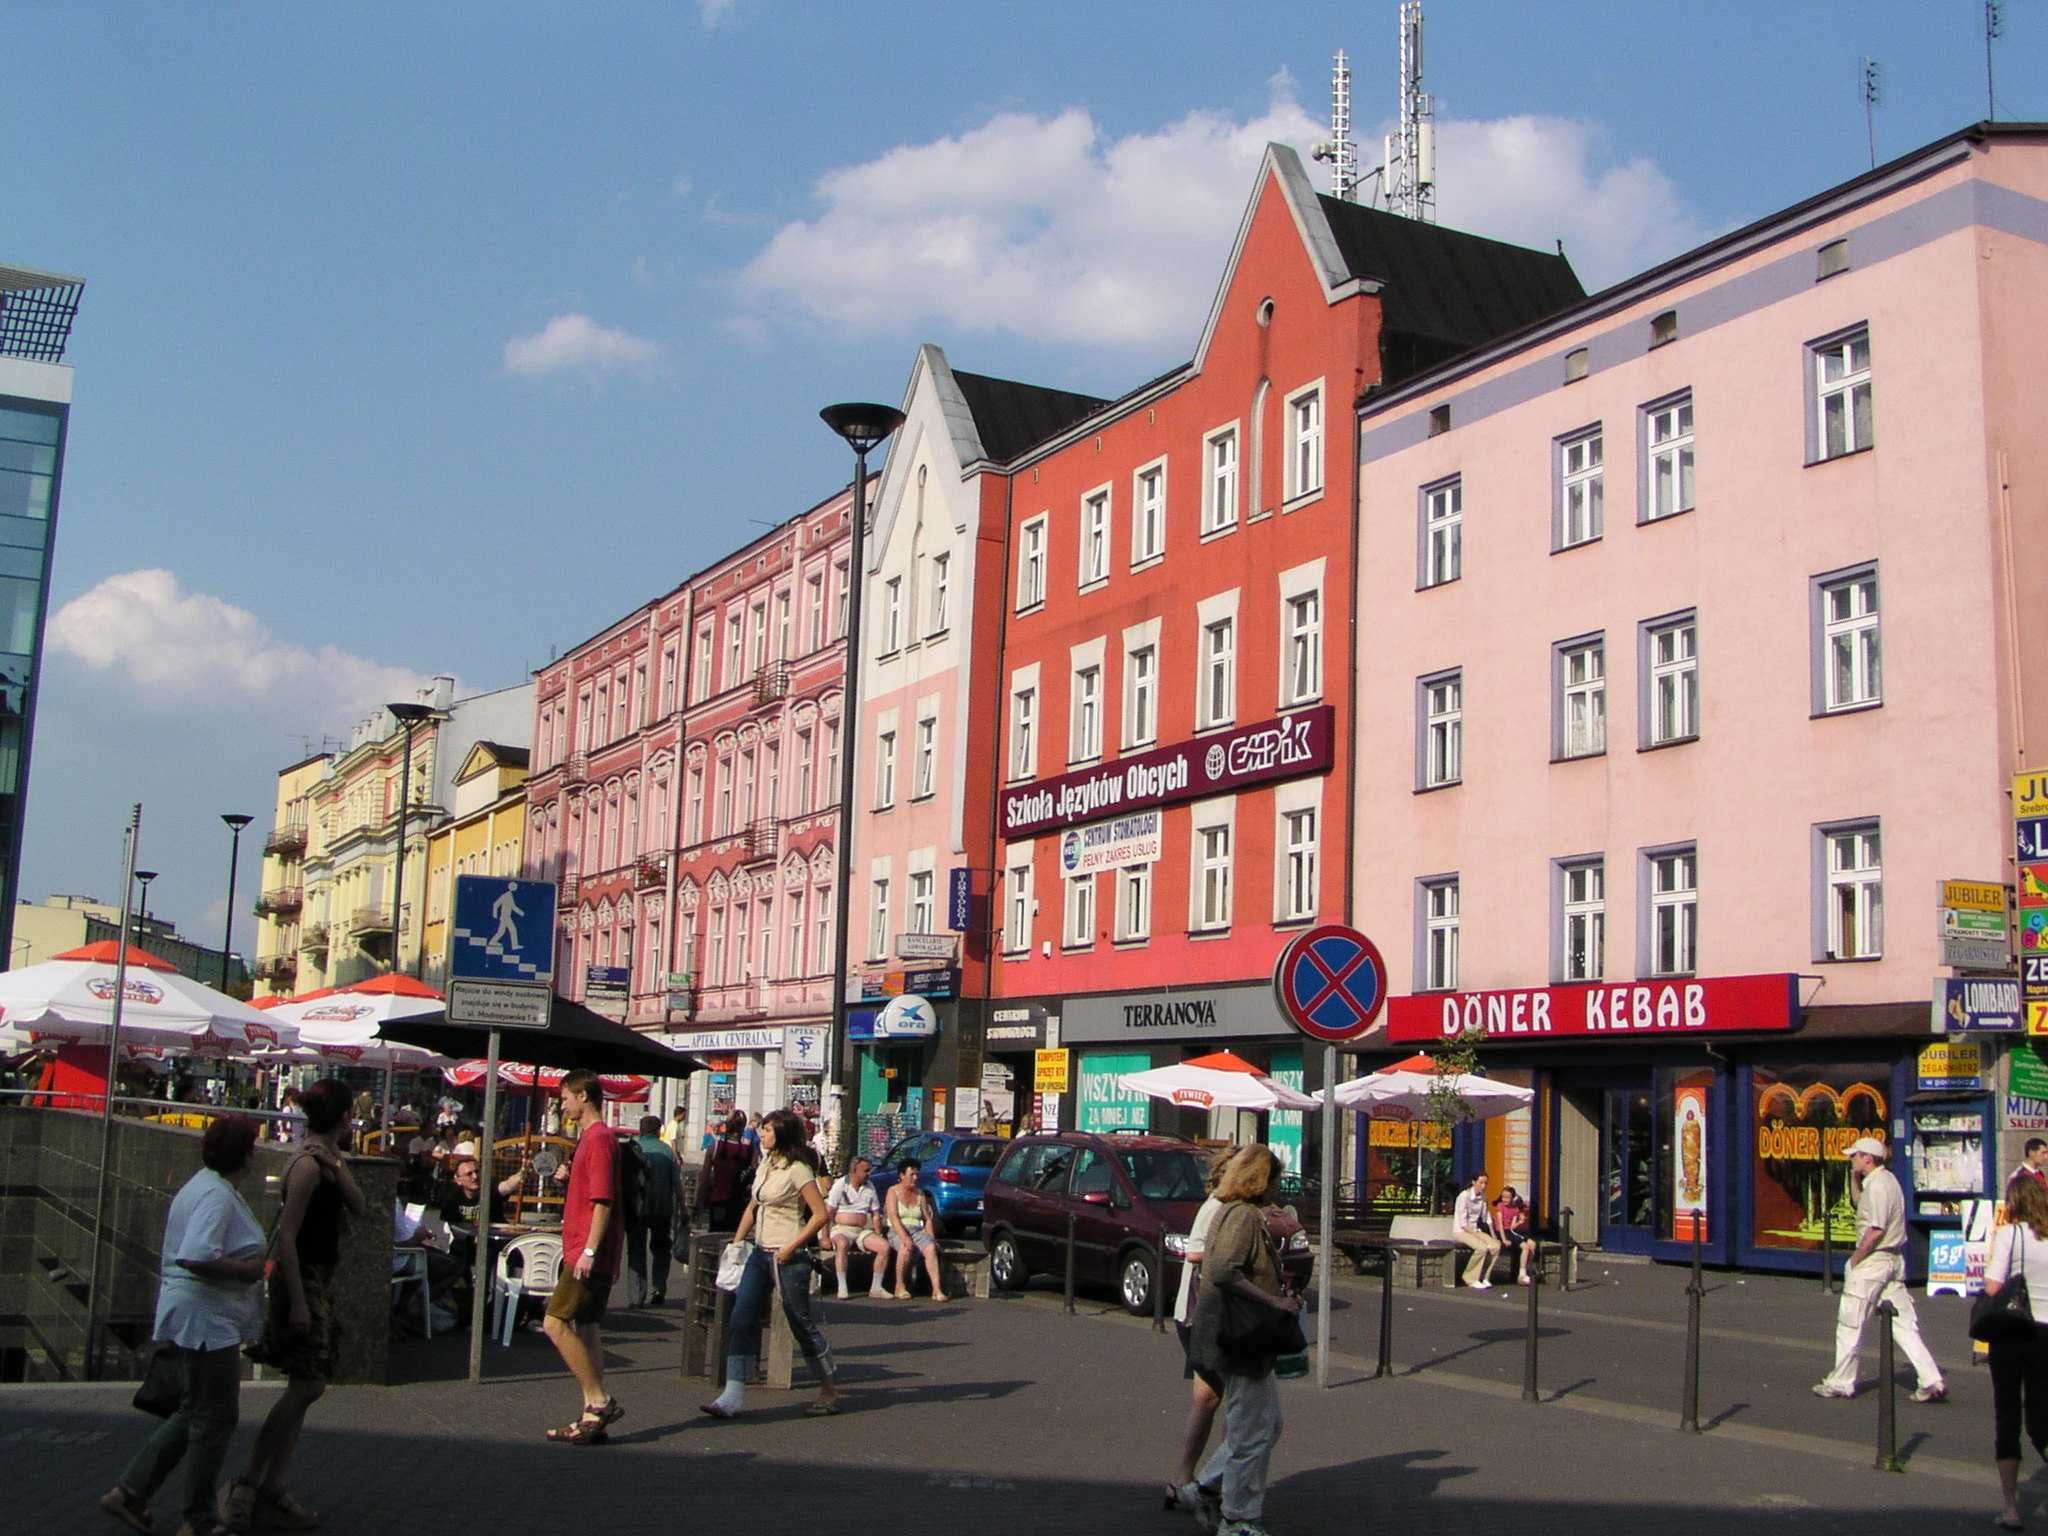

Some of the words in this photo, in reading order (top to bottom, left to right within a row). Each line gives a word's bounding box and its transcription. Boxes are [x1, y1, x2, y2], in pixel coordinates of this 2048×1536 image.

[1006, 789, 1053, 828] Szkoła
[1056, 772, 1123, 822] Języków
[1126, 754, 1188, 801] Obcych
[1084, 823, 1112, 848] CENTRUM
[1105, 846, 1131, 864] ZAKRES
[1944, 886, 2001, 907] JUBILER
[1442, 992, 1551, 1035] DÖNER
[1585, 984, 1706, 1031] KEBAB
[1964, 983, 2019, 1013] LOMBARD
[1123, 1000, 1217, 1028] TERRANOVA
[692, 1033, 720, 1048] APTEKA
[725, 1031, 774, 1047] CENTRALNA
[790, 1025, 821, 1035] APTEKA
[1921, 1048, 1979, 1060] JUBILER
[1759, 1119, 1820, 1160] DÖNER
